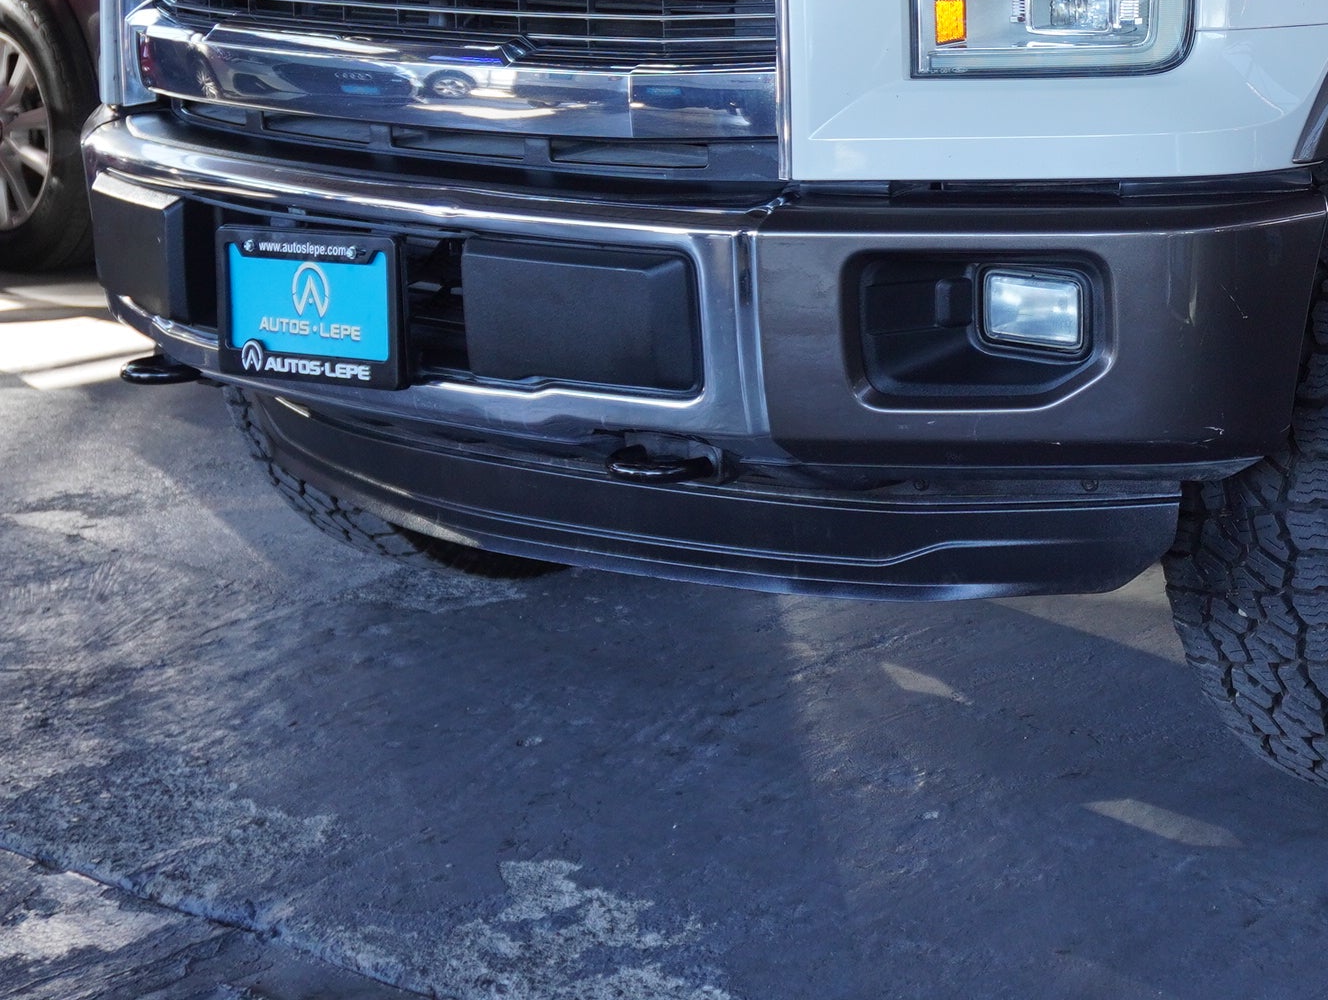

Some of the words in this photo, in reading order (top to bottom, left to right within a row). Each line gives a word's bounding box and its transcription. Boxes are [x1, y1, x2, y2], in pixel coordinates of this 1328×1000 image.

[258, 241, 346, 258] www.autoslepe.com
[259, 316, 310, 335] AUTOS
[319, 324, 361, 341] LEPE
